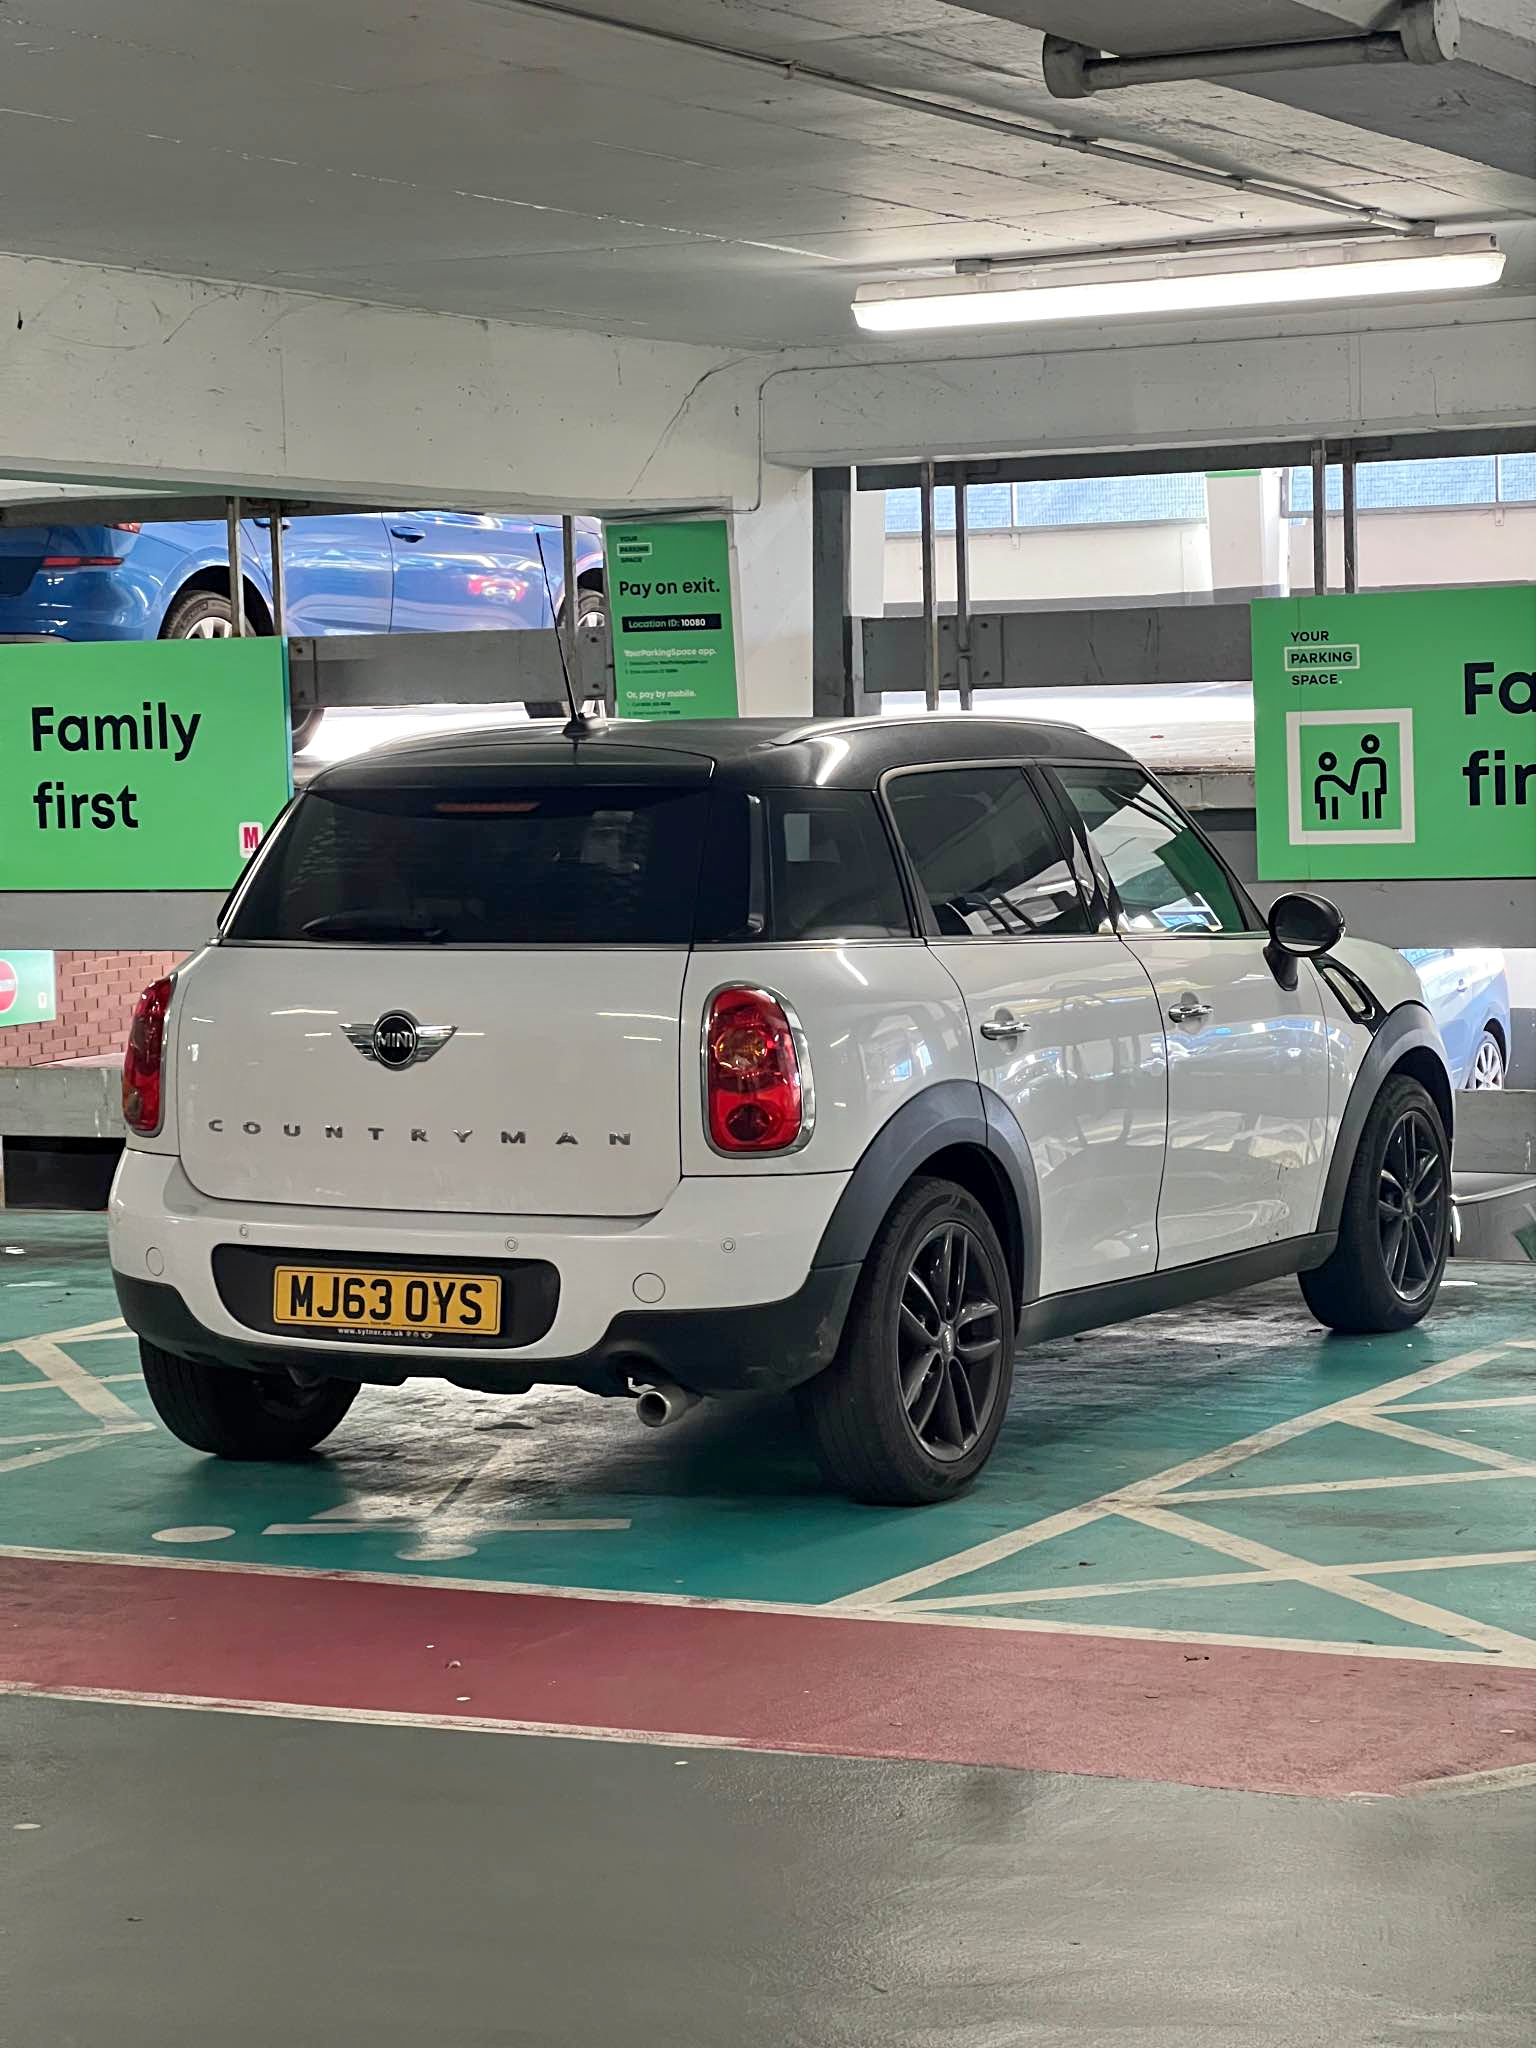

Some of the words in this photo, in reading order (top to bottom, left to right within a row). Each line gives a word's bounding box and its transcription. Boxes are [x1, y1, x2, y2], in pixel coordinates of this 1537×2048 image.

[619, 581, 652, 599] Pay
[655, 582, 678, 595] on
[682, 576, 721, 594] exit.
[628, 620, 667, 629] Location
[681, 618, 706, 627] 10080
[1290, 630, 1330, 642] YOUR
[1290, 651, 1353, 665] PARKING
[639, 691, 654, 700] pay
[655, 690, 666, 700] by
[31, 701, 202, 762] Family
[32, 781, 139, 830] first
[243, 826, 259, 849] M
[376, 1031, 414, 1048] MINI
[208, 1119, 631, 1146] COUNTRYMAN
[289, 1274, 393, 1321] MJ63
[404, 1280, 483, 1326] OYS
